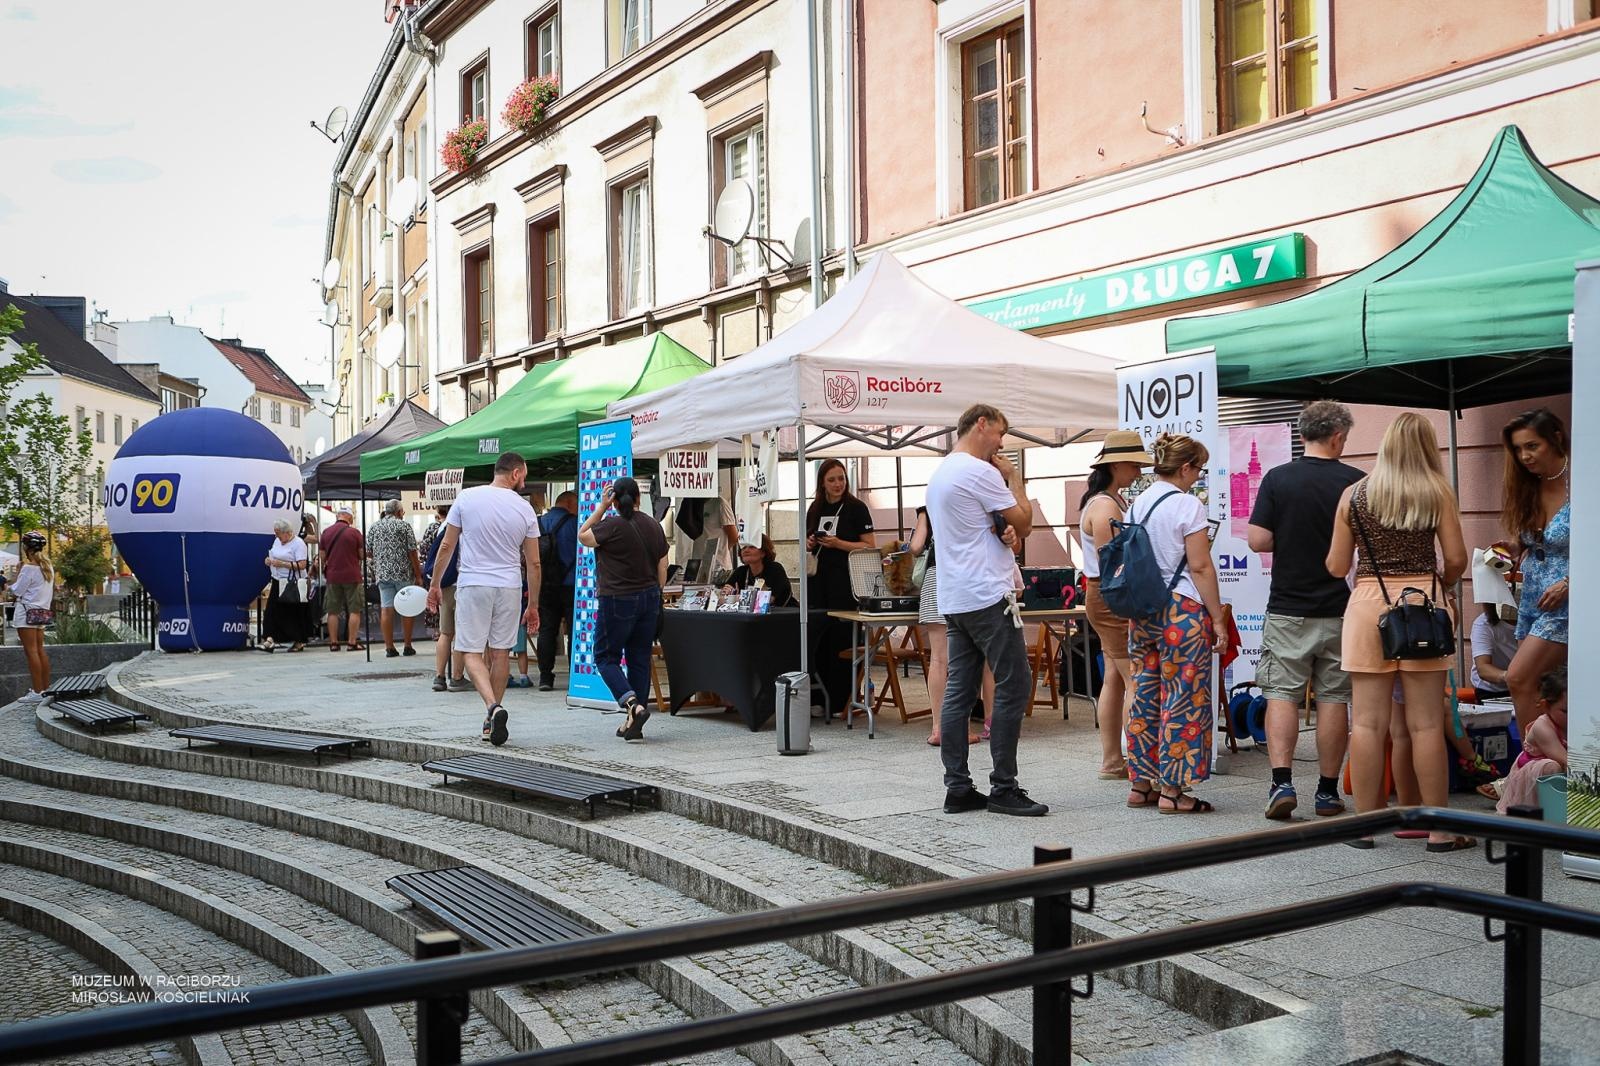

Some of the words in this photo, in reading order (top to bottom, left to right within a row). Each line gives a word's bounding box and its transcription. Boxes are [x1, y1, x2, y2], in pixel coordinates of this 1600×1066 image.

[1106, 253, 1241, 308] DŁUGA
[1252, 245, 1276, 280] 7
[867, 377, 942, 393] Racibórz
[867, 397, 888, 409] 1217
[1125, 372, 1202, 422] NOPI
[667, 452, 707, 469] MUZEUM
[427, 472, 444, 485] MUZEUM
[670, 470, 714, 489] OSTRAWY
[135, 479, 174, 507] 90
[230, 483, 301, 512] RADIO
[172, 621, 187, 632] 90
